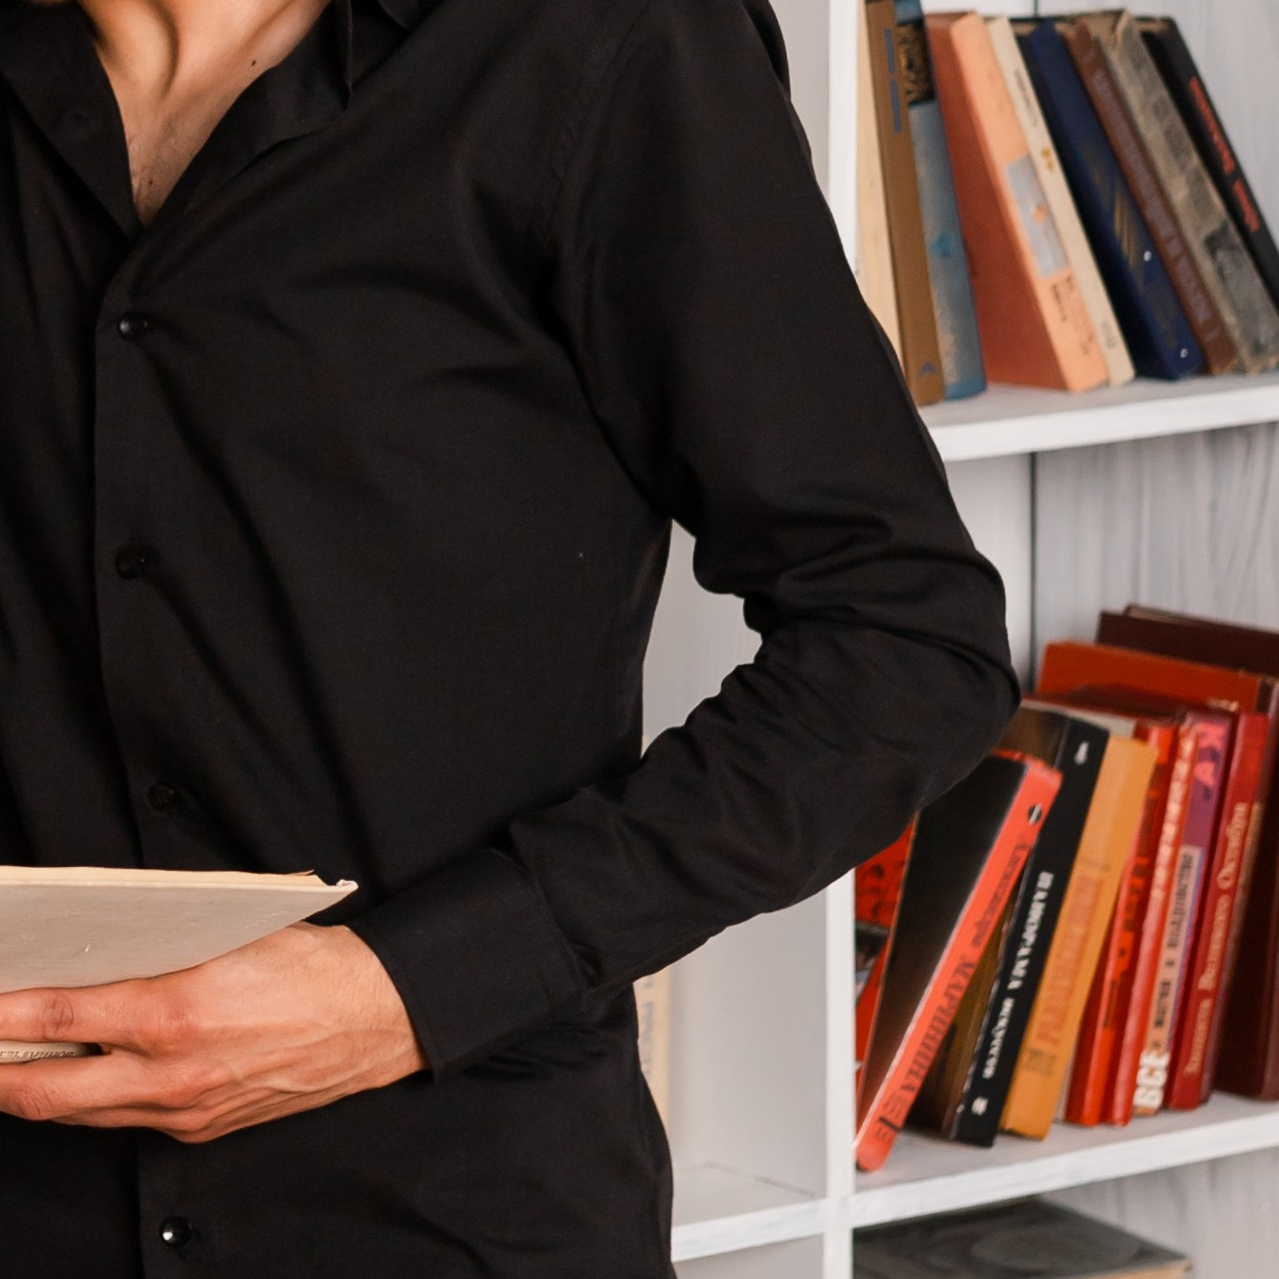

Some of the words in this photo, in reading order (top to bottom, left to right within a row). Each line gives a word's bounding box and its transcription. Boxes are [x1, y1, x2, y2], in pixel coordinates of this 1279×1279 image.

[1008, 871, 1055, 991] ПАНОРАМА
[901, 952, 977, 1091] МАРИНИНА
[1134, 1052, 1171, 1108] ВСЕ
